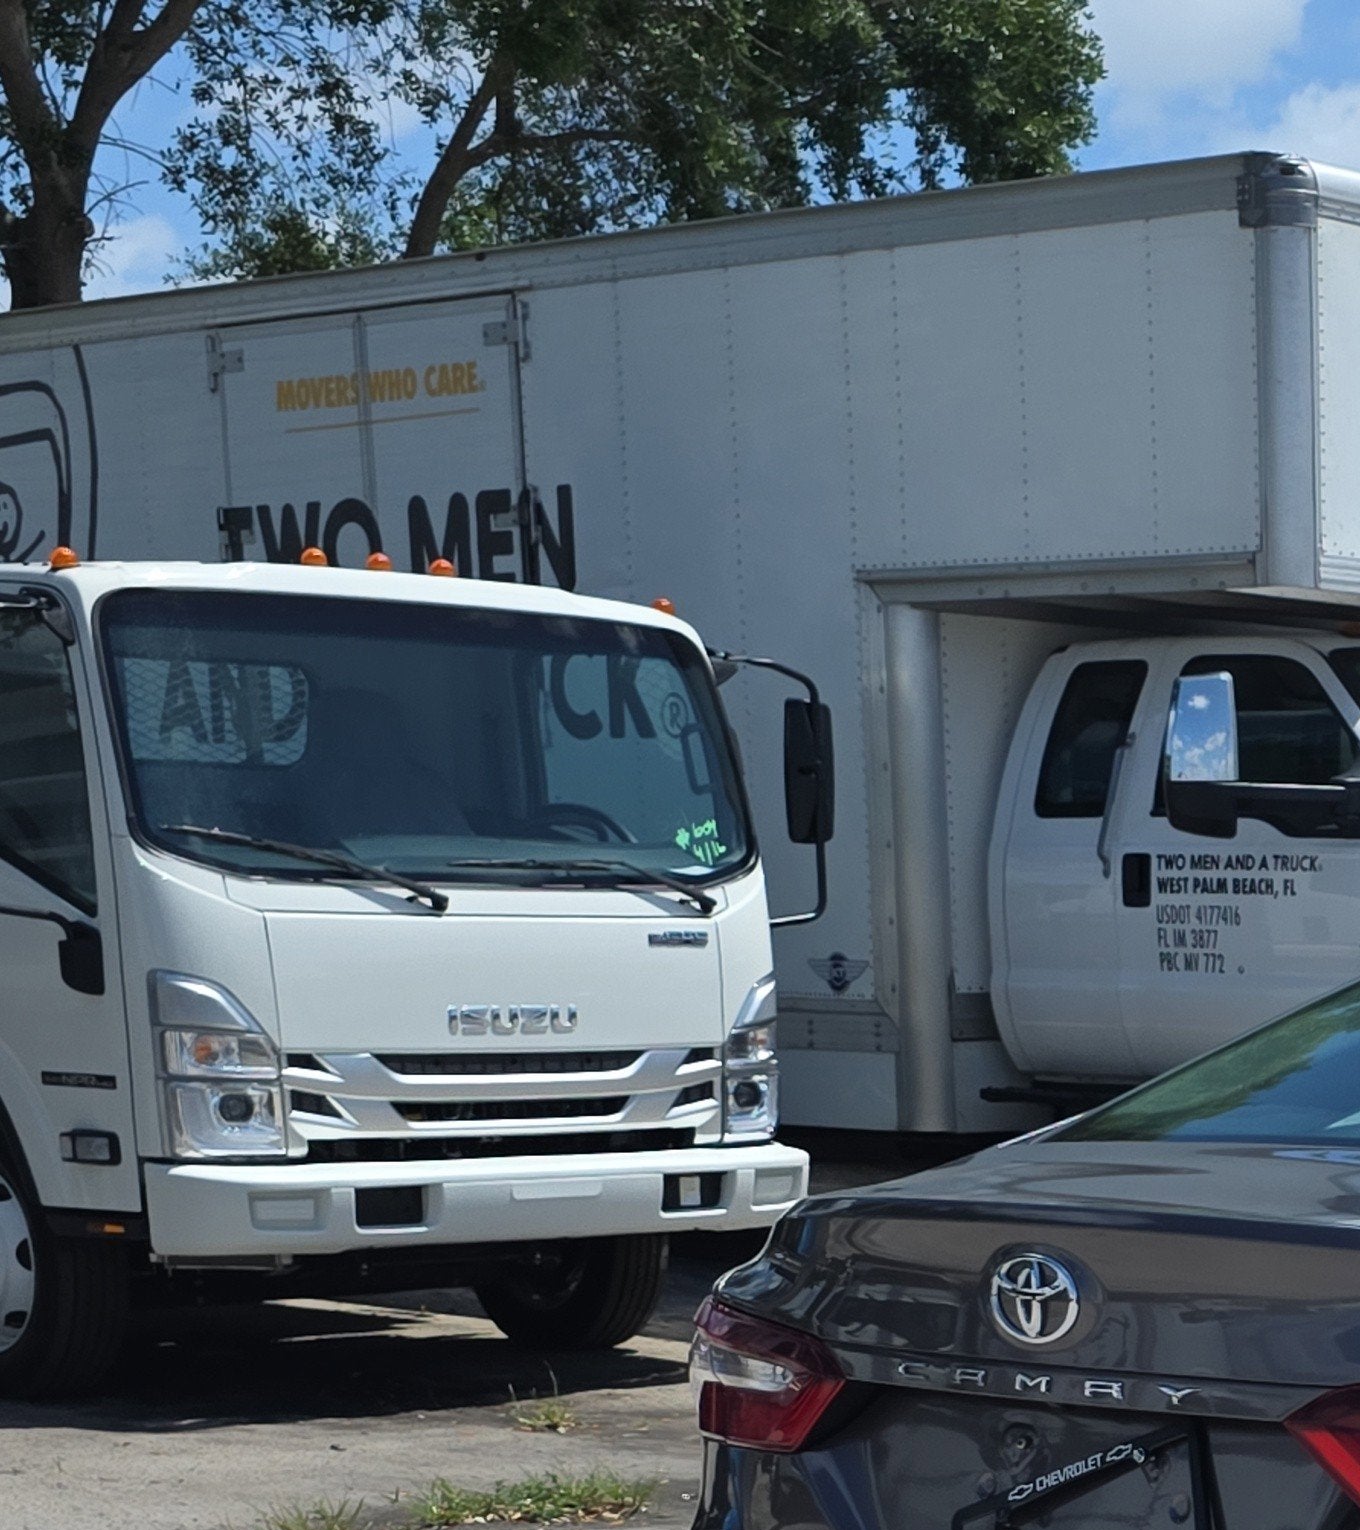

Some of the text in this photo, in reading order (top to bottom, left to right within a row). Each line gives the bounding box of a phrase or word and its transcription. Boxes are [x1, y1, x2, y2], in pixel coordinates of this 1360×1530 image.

[275, 372, 360, 412] MOVERS
[369, 367, 417, 403] WHO
[219, 484, 577, 593] TWO MEN
[1156, 853, 1186, 871] TWO
[1190, 854, 1221, 871] MEN
[1224, 854, 1256, 871] AND
[1258, 855, 1270, 871] A
[1157, 876, 1297, 899] WEST PALM BEACH, FL
[1156, 904, 1191, 925] USDOT
[1157, 928, 1169, 948] FL
[1159, 952, 1180, 972] PBC
[1203, 953, 1225, 974] 772
[447, 1003, 577, 1036] ISUZU
[898, 1362, 1203, 1405] CAMRY
[1035, 1452, 1104, 1493] CHEVROLET
